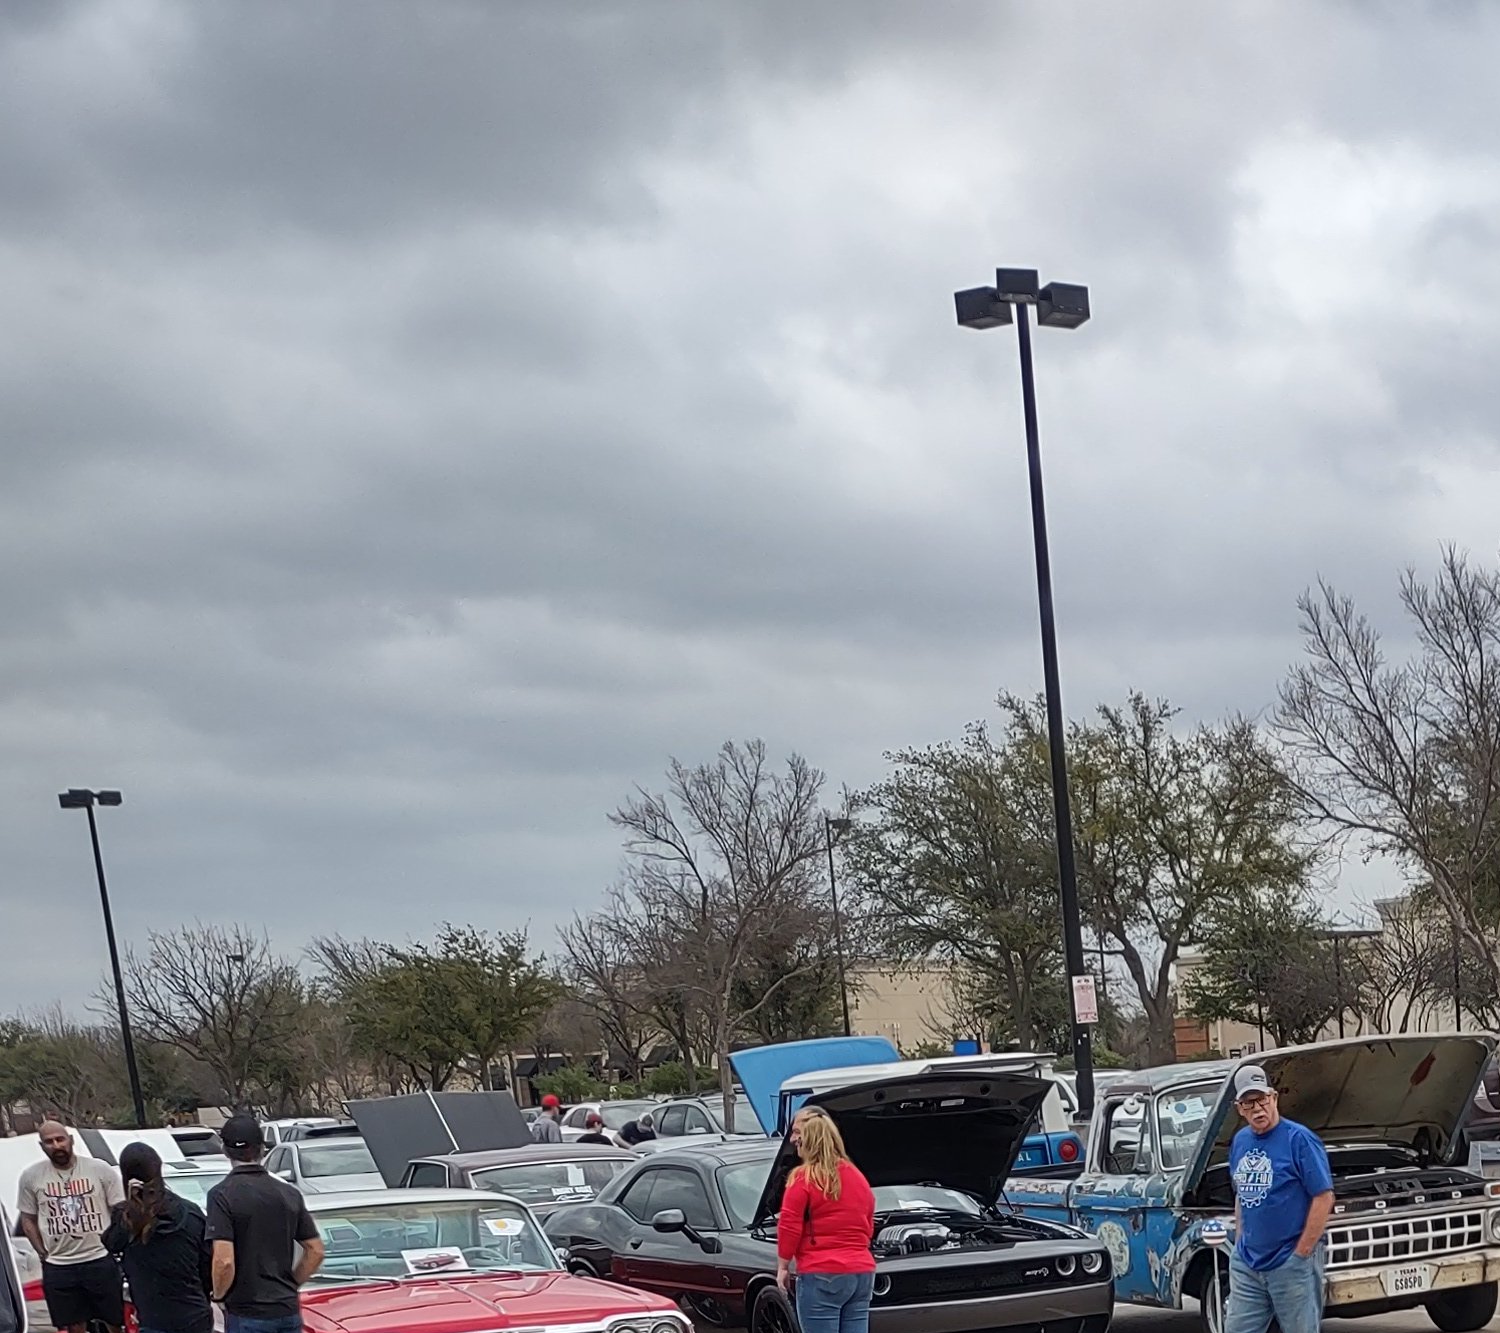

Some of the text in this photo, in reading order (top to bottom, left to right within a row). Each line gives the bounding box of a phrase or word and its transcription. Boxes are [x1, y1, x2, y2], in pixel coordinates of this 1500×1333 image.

[1334, 1191, 1462, 1214] FORD
[46, 1213, 104, 1236] RESECT
[1399, 1267, 1418, 1275] TEXAS
